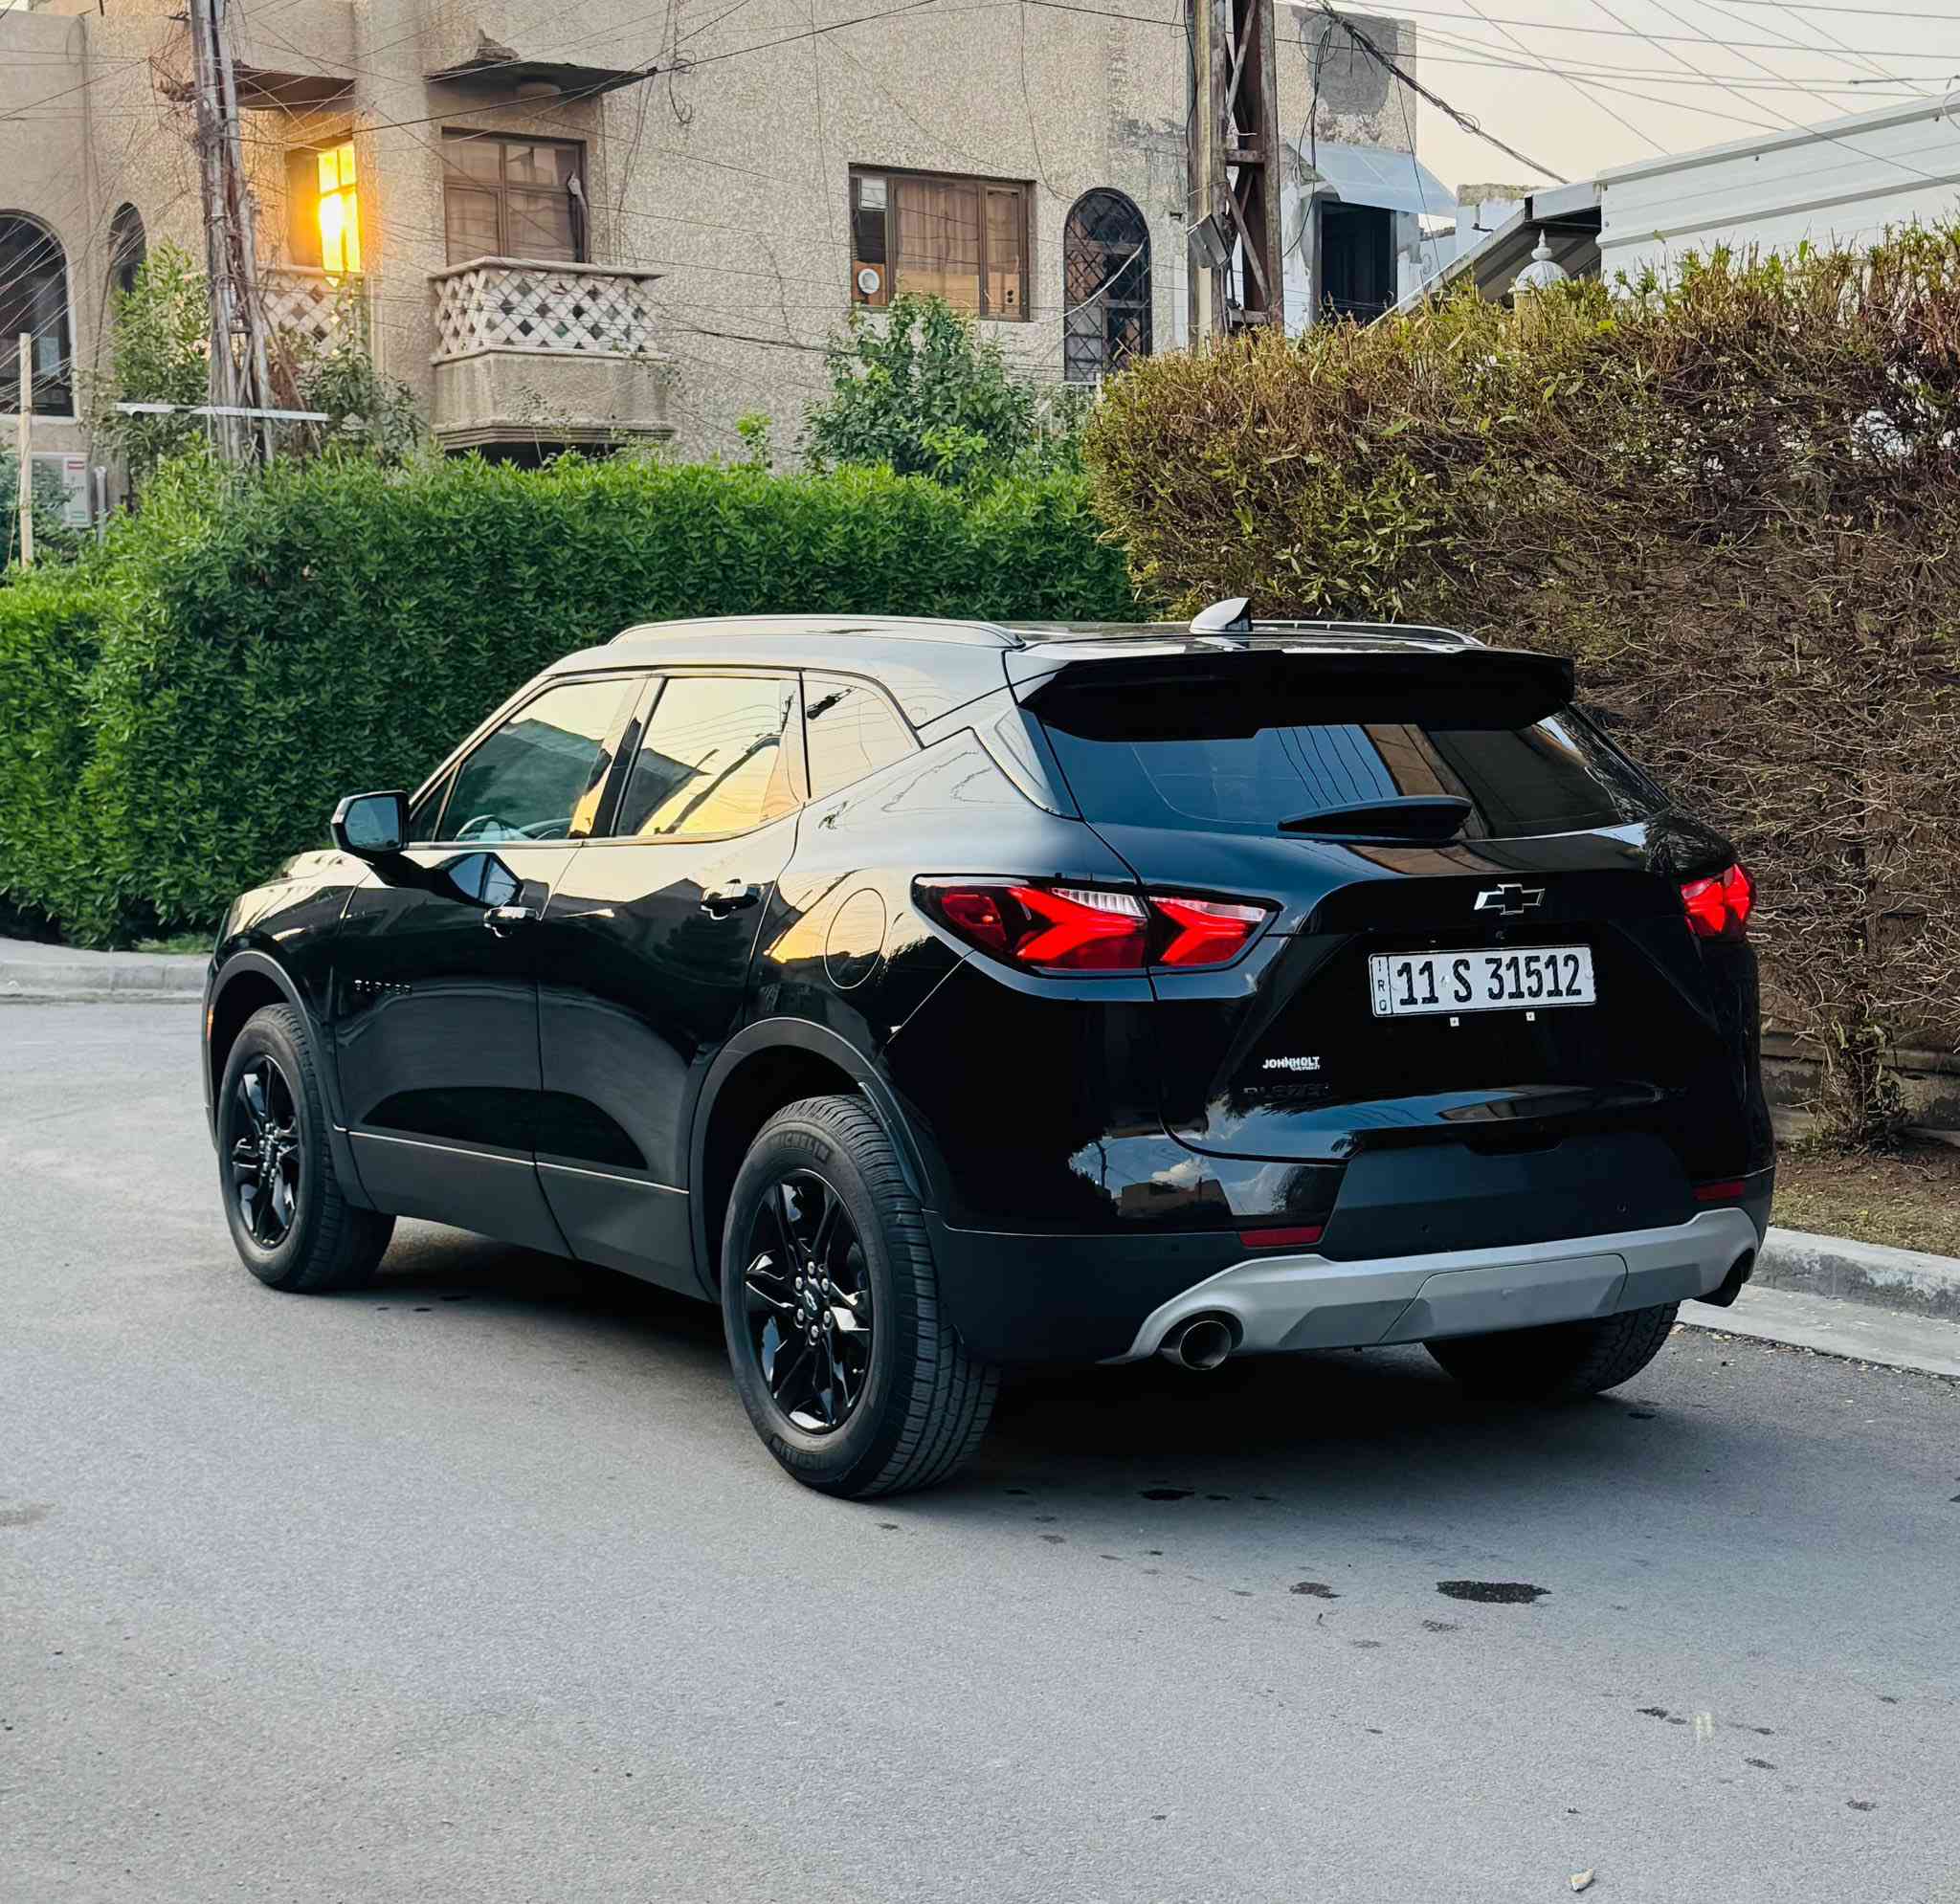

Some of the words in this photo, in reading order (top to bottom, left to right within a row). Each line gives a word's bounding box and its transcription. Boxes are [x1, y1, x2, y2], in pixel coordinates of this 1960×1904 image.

[1397, 961, 1439, 1006] 11
[1452, 959, 1473, 1003] S
[1484, 954, 1583, 1001] 31512
